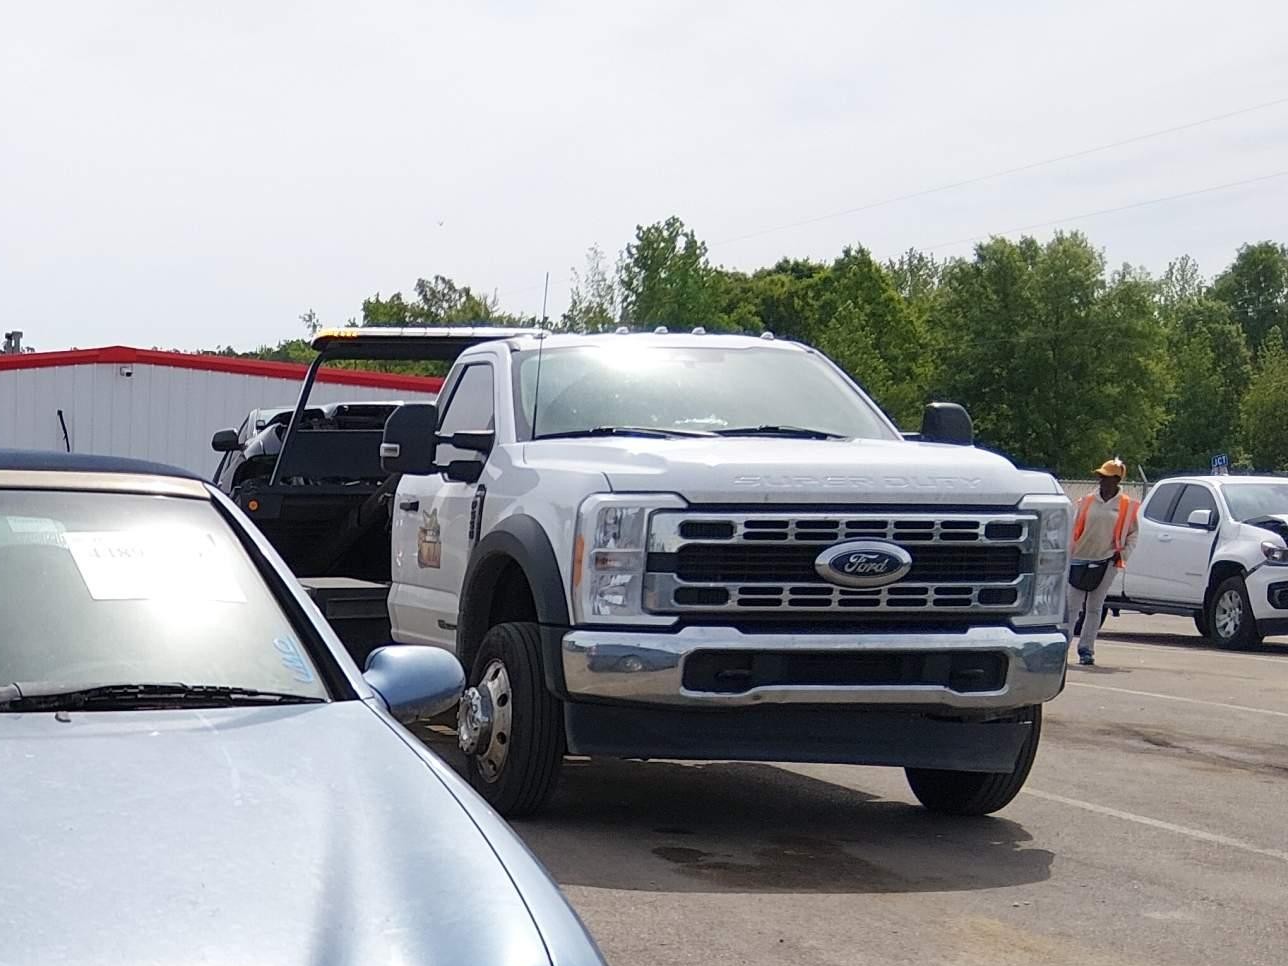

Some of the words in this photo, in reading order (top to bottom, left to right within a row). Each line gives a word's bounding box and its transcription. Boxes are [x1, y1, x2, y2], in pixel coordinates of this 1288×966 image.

[1213, 455, 1226, 466] JCT
[733, 475, 874, 488] SUPER
[883, 475, 982, 488] DUTY
[844, 553, 888, 574] Ford
